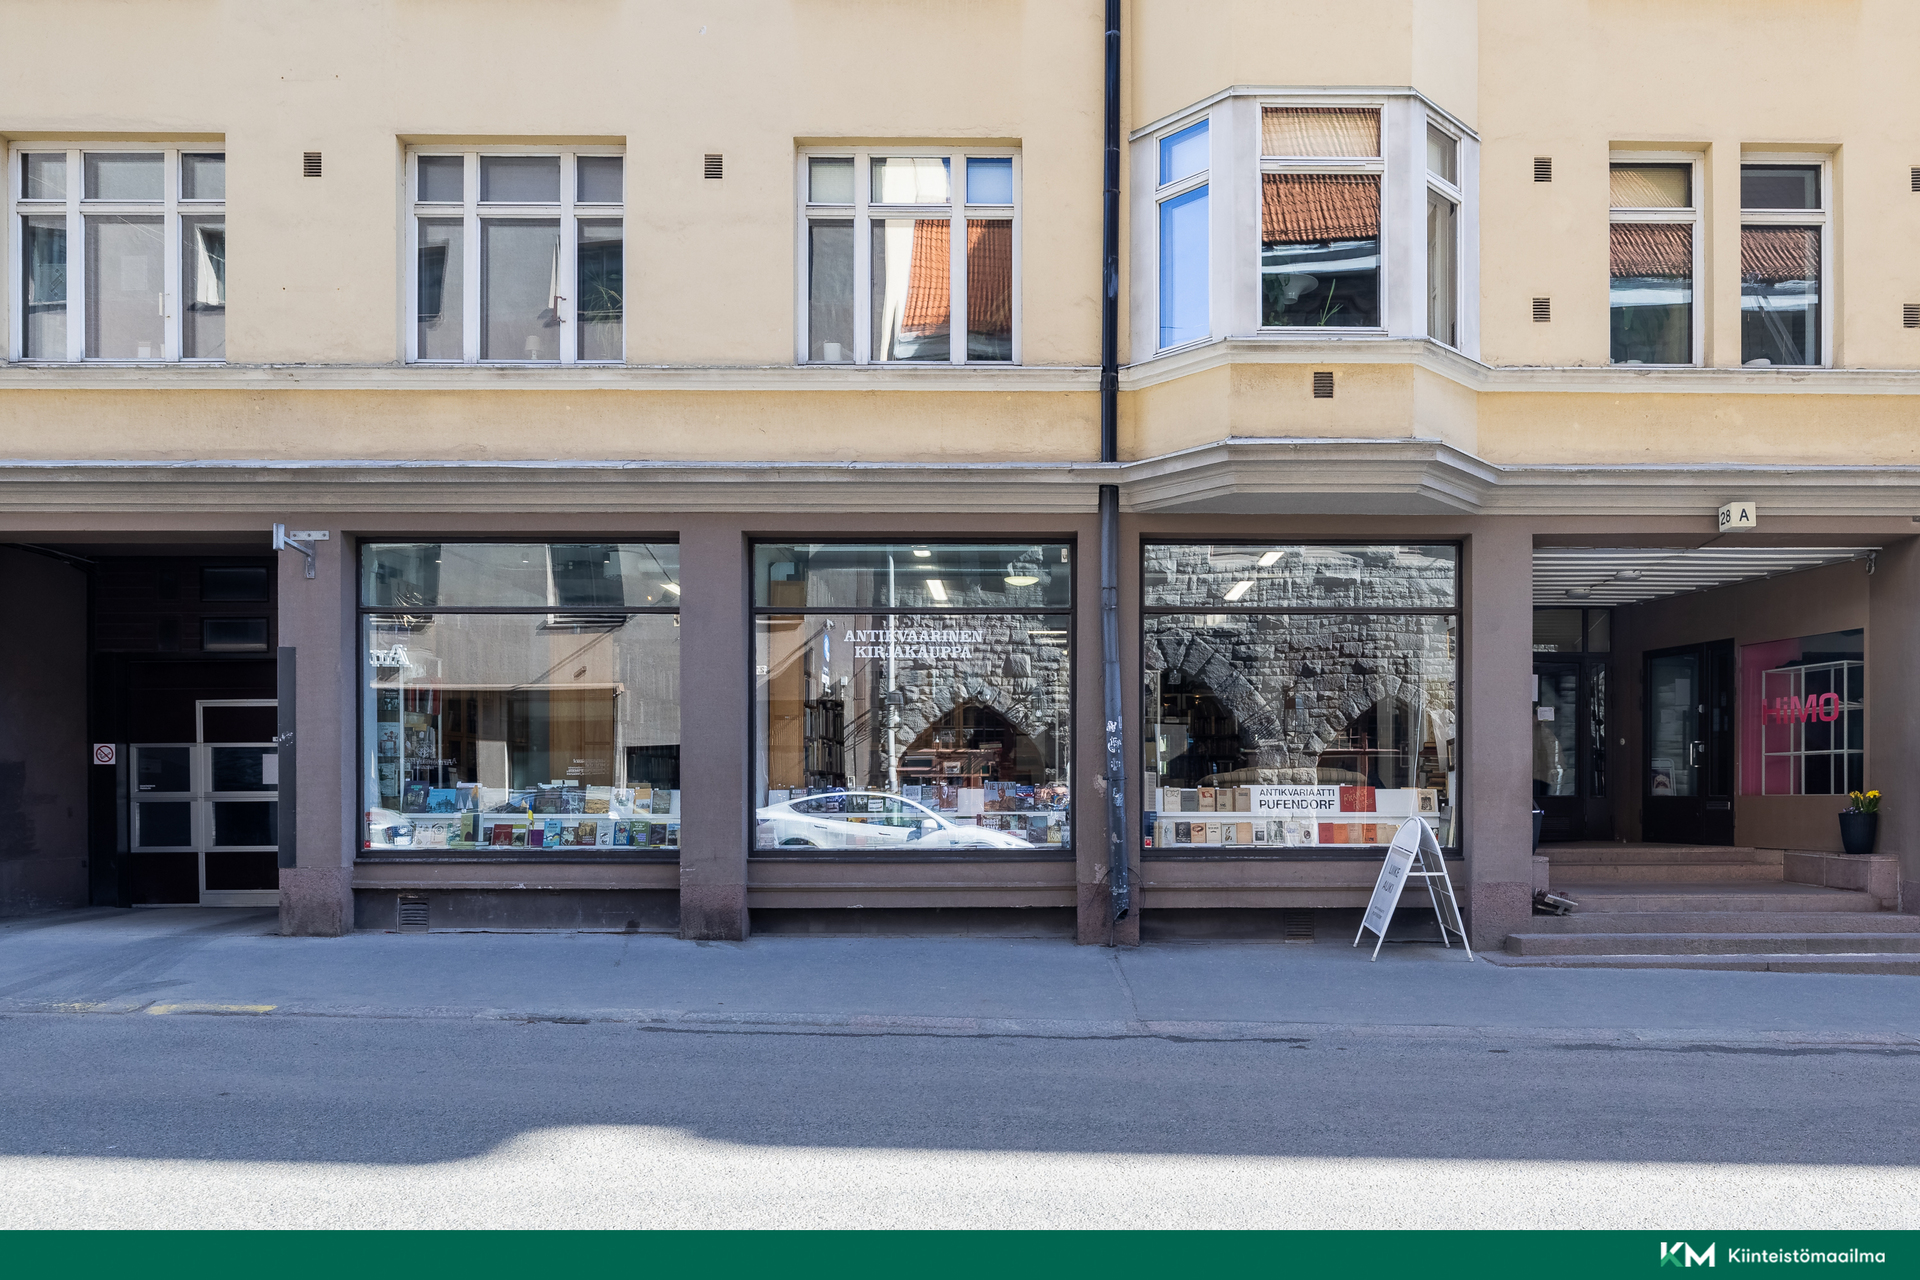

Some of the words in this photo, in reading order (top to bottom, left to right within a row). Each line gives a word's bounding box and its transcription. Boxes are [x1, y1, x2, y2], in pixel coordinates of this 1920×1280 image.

[1720, 509, 1732, 526] 28
[1739, 508, 1749, 521] A
[844, 630, 983, 642] ANTIKVAARINEN
[855, 646, 973, 659] KIRJAKAUPPA
[1259, 788, 1335, 797] ANTIKVARIAATTI
[1259, 799, 1335, 810] PUFENDORF
